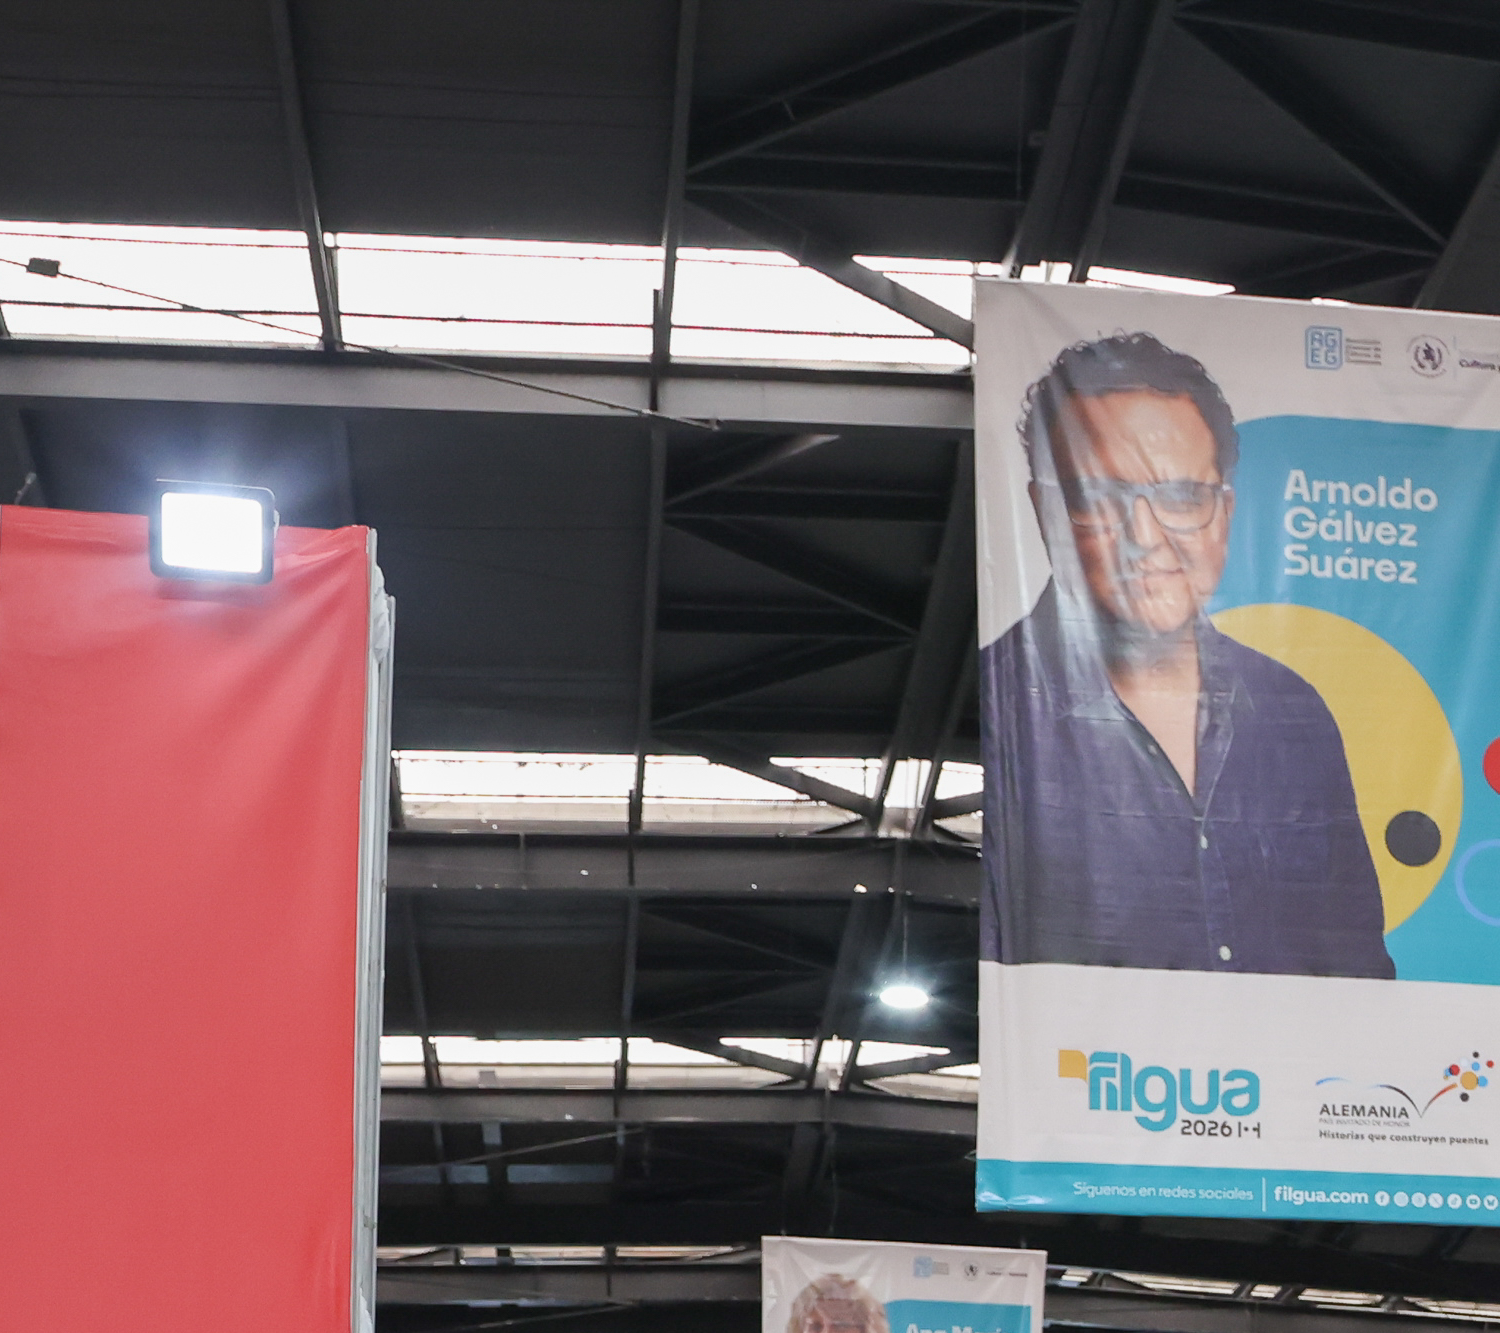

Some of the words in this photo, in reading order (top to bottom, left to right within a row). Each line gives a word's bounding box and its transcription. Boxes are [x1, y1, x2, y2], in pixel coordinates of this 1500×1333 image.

[1284, 469, 1439, 512] Arnoldo
[1284, 505, 1419, 547] Gálvez
[1284, 543, 1419, 585] Suárez
[1088, 1051, 1261, 1132] filgua
[1319, 1103, 1410, 1120] ALEMANIA
[1180, 1119, 1233, 1137] 2026
[1318, 1130, 1366, 1142] Historias
[1368, 1132, 1388, 1144] que
[1389, 1133, 1447, 1146] construyen
[1449, 1135, 1490, 1147] puentes
[1073, 1181, 1137, 1199] Síguenos
[1139, 1186, 1157, 1197] en
[1158, 1184, 1196, 1199] redes
[1198, 1185, 1254, 1201] sociales
[1273, 1185, 1369, 1206] filgua.com
